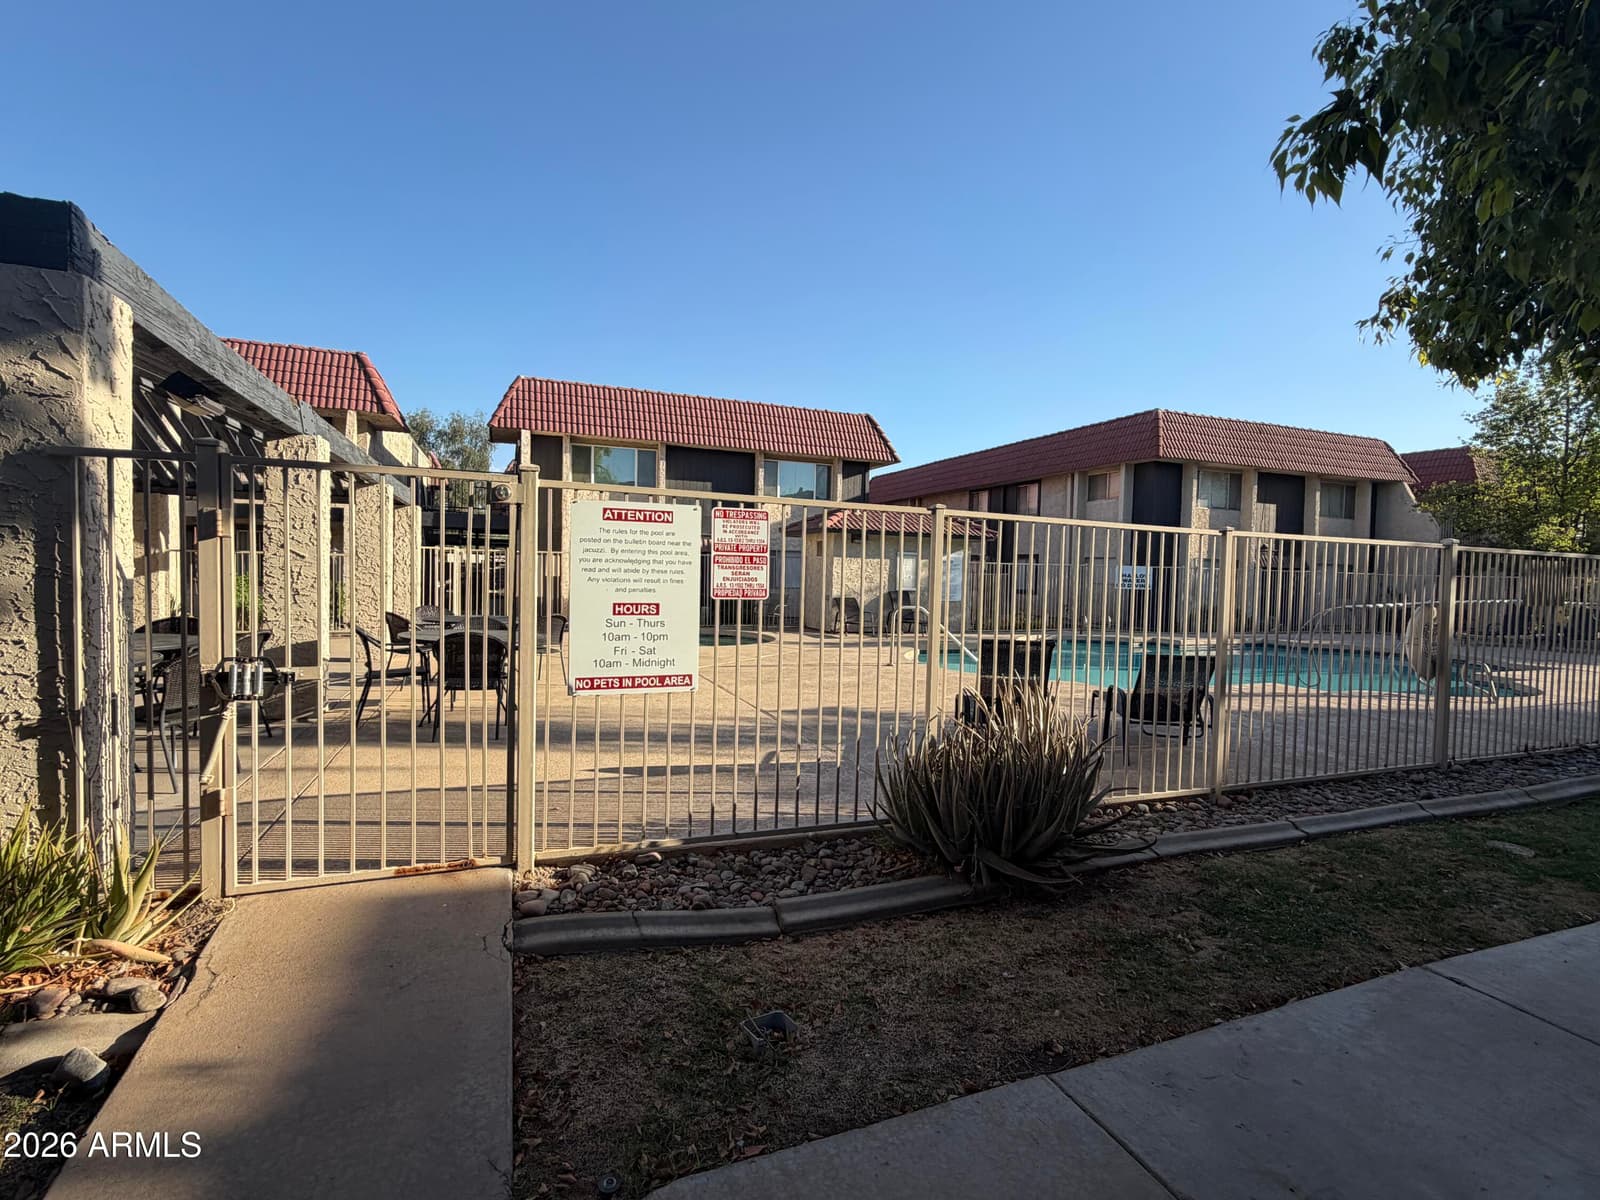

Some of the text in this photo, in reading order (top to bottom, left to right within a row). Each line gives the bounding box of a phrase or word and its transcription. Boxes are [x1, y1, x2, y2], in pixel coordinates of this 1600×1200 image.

[603, 509, 673, 522] ATTENTION
[715, 510, 768, 520] NO TRESPASSING
[610, 546, 619, 555] By
[620, 548, 646, 556] entering
[714, 543, 767, 552] PRIVATE PROPERTY
[604, 557, 651, 566] acknowledging
[744, 556, 750, 564] EL
[614, 604, 658, 615] HOURS
[605, 618, 626, 628] Sun
[636, 618, 666, 628] Thurs
[602, 632, 631, 642] 10am
[641, 632, 669, 642] 10pm
[613, 646, 628, 656] Fri
[638, 646, 656, 656] Sat
[593, 659, 622, 668] 10am
[632, 658, 676, 669] Midnight
[576, 676, 690, 689] NO PETS IN POOL AREA
